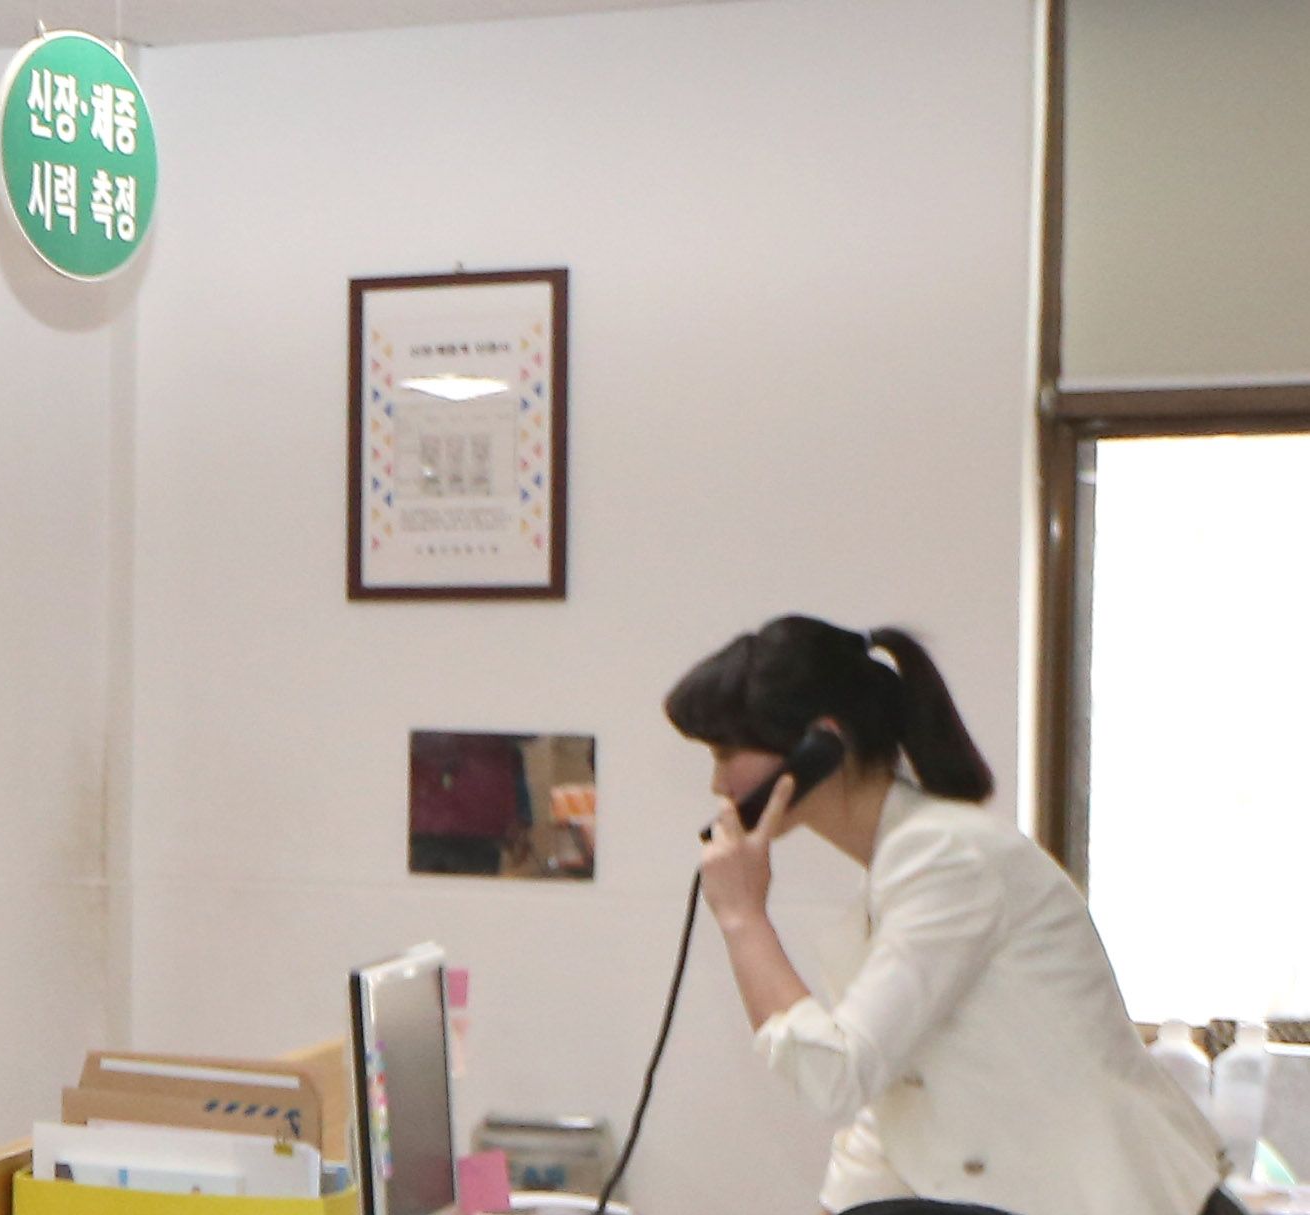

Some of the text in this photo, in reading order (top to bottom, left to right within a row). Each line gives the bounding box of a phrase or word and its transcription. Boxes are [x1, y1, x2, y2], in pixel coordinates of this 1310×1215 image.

[27, 69, 138, 155] 신장·체중
[27, 160, 137, 242] 시력 측정
